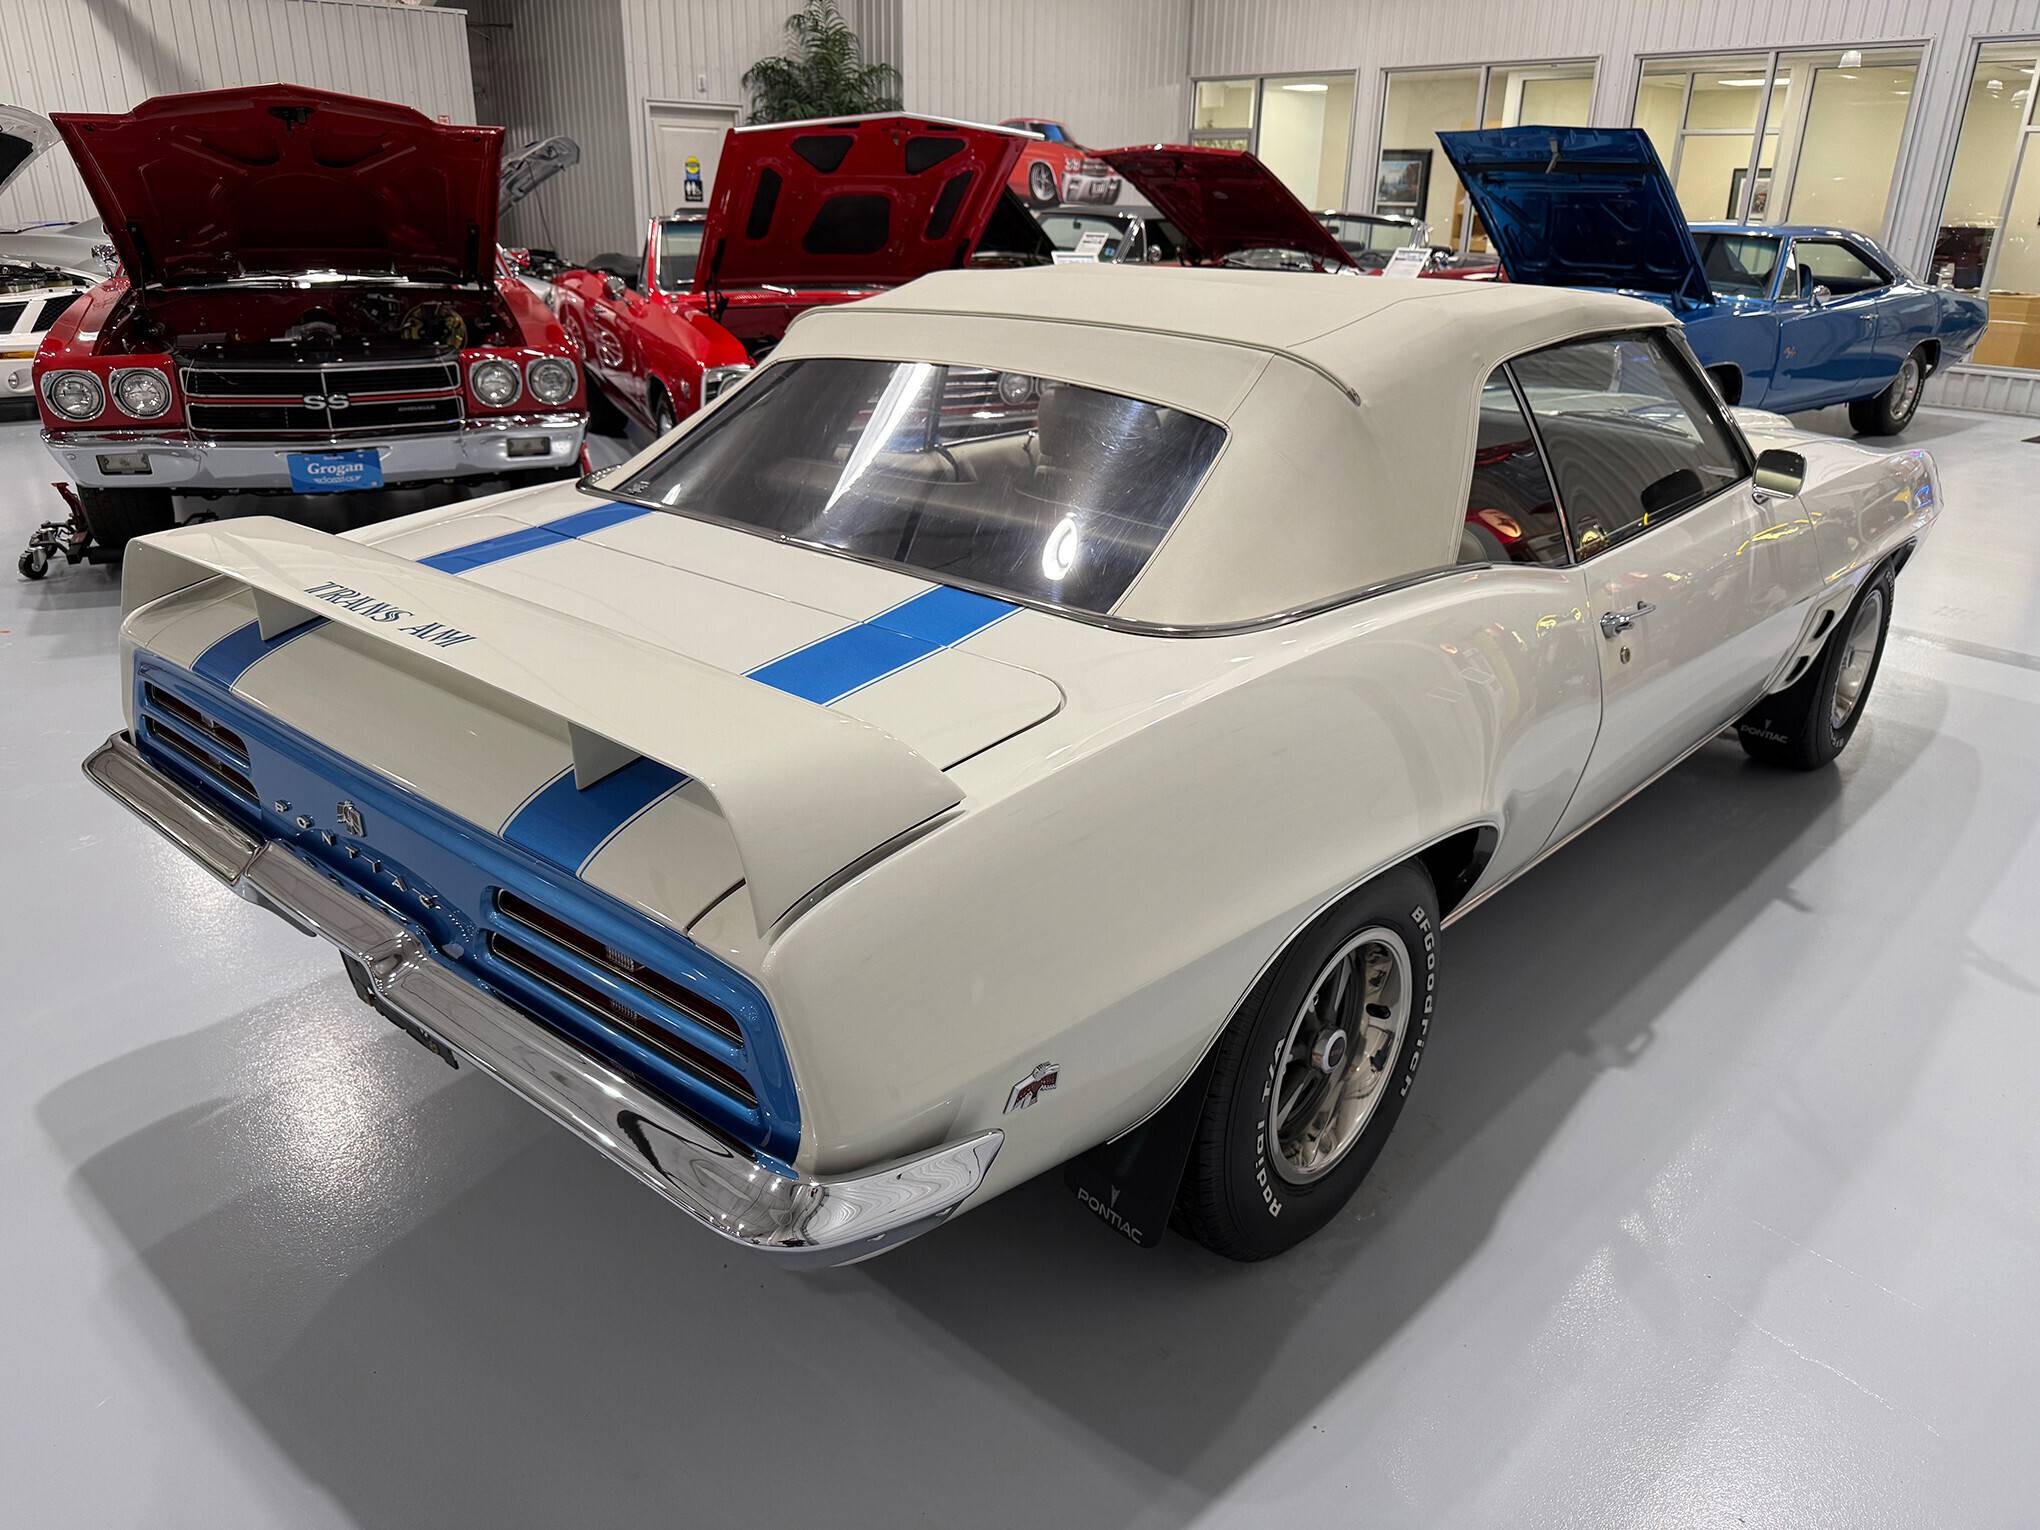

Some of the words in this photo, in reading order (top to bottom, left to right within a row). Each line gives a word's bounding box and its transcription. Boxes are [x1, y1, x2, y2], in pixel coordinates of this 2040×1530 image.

[303, 395, 349, 410] SS
[307, 463, 364, 476] Grogan
[304, 581, 415, 623] TRANS
[398, 622, 477, 648] AM
[1740, 724, 1788, 743] PONTIAC
[1255, 1119, 1282, 1217] Radial
[1078, 1187, 1143, 1244] PONTIAC
